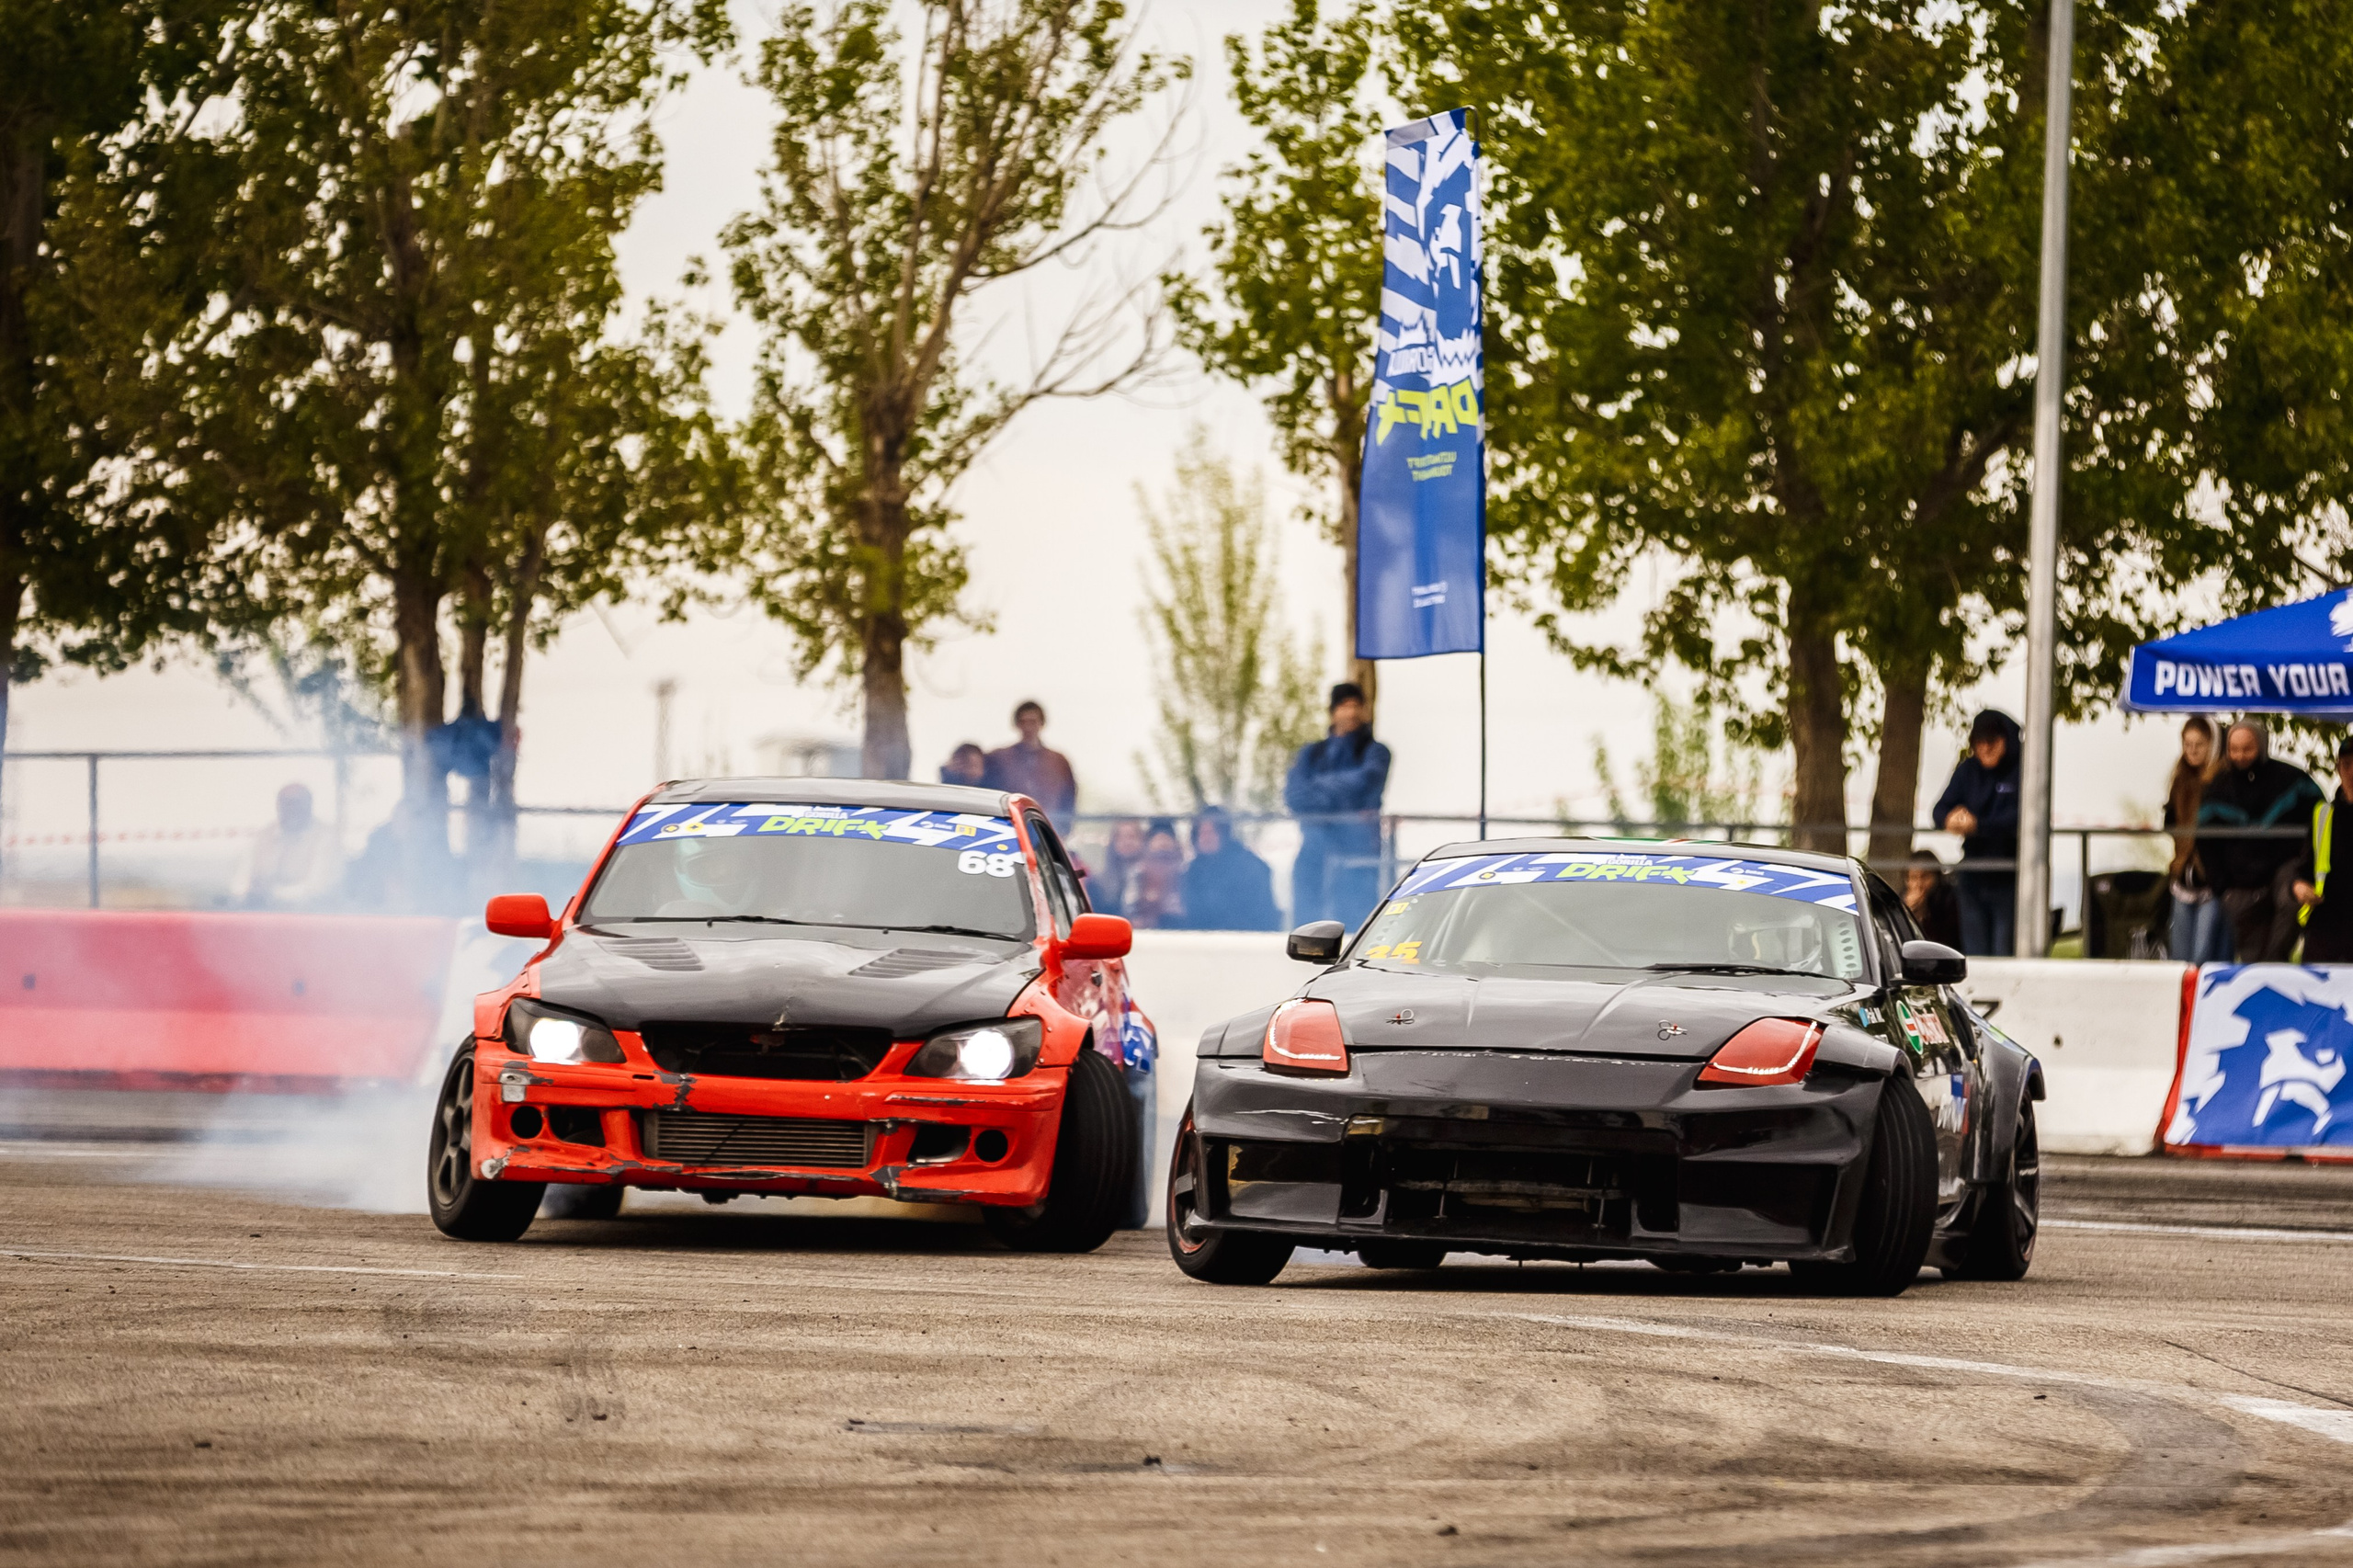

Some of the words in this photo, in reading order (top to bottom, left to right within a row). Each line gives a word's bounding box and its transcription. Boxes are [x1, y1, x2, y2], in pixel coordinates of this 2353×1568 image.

[2154, 660, 2262, 698] POWER
[2268, 663, 2350, 698] YOUR
[756, 815, 890, 840] DRIFT
[804, 811, 848, 820] GORILLA
[958, 850, 1016, 879] 68
[1555, 862, 1696, 885] DRIFT
[1607, 858, 1654, 866] GORILLA
